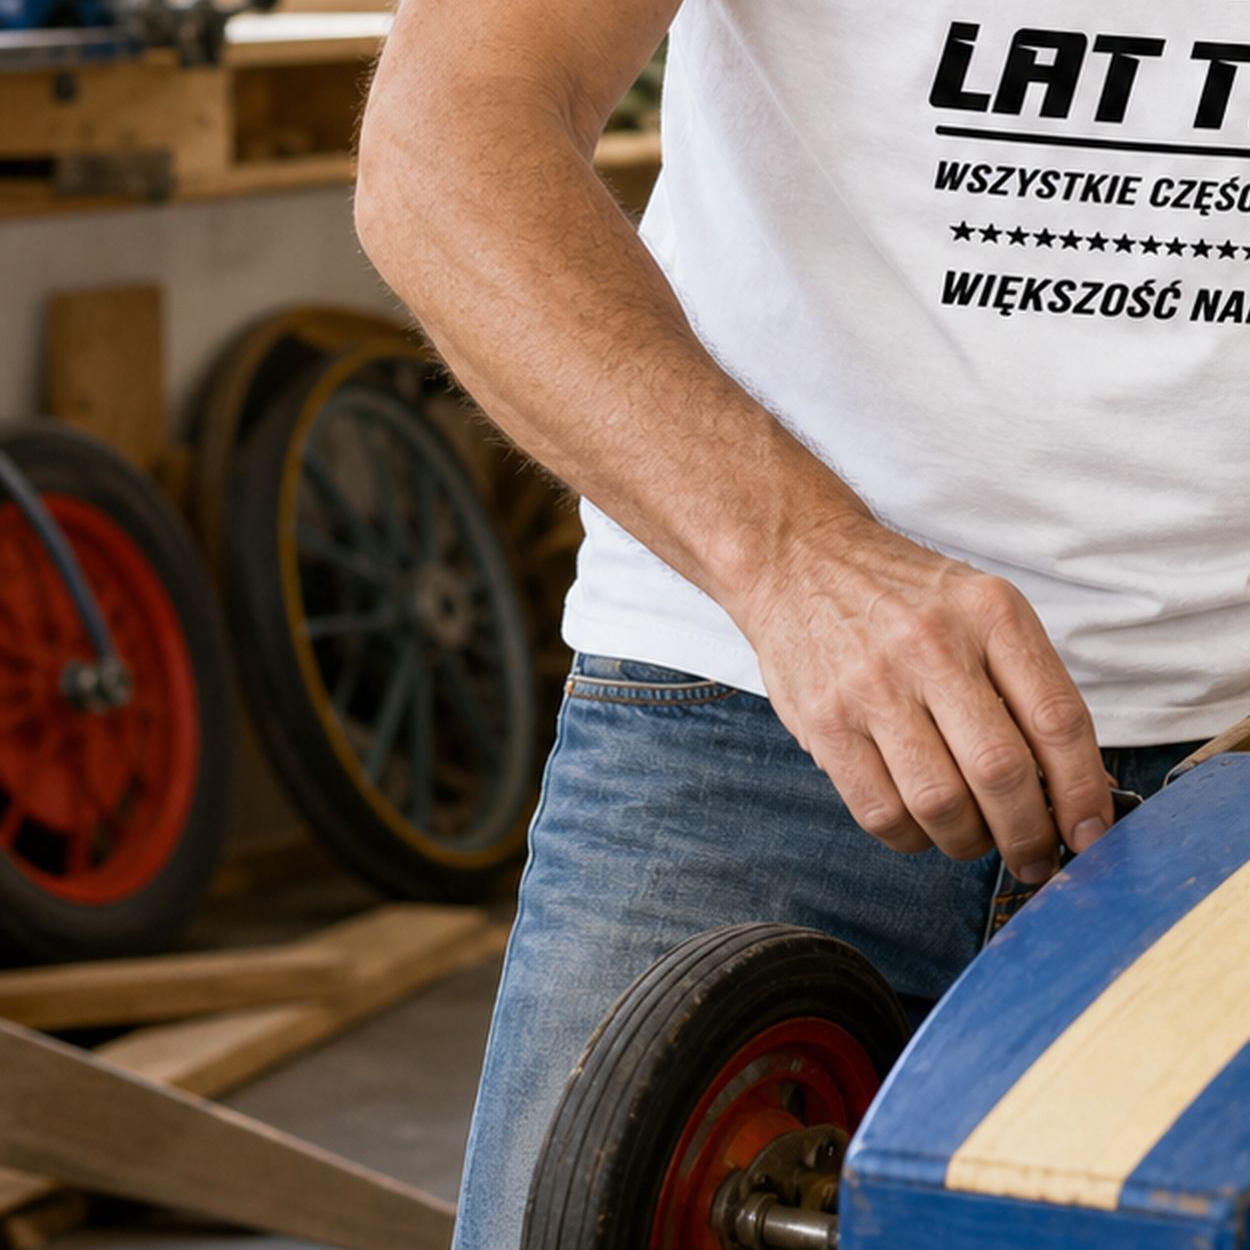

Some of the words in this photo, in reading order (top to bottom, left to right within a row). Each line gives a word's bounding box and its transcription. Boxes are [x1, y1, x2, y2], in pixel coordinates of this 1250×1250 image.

[928, 21, 1167, 124] LAT
[934, 160, 1143, 206] WSZYSTKIE
[941, 270, 1182, 320] WIĘKSZOŚĆ
